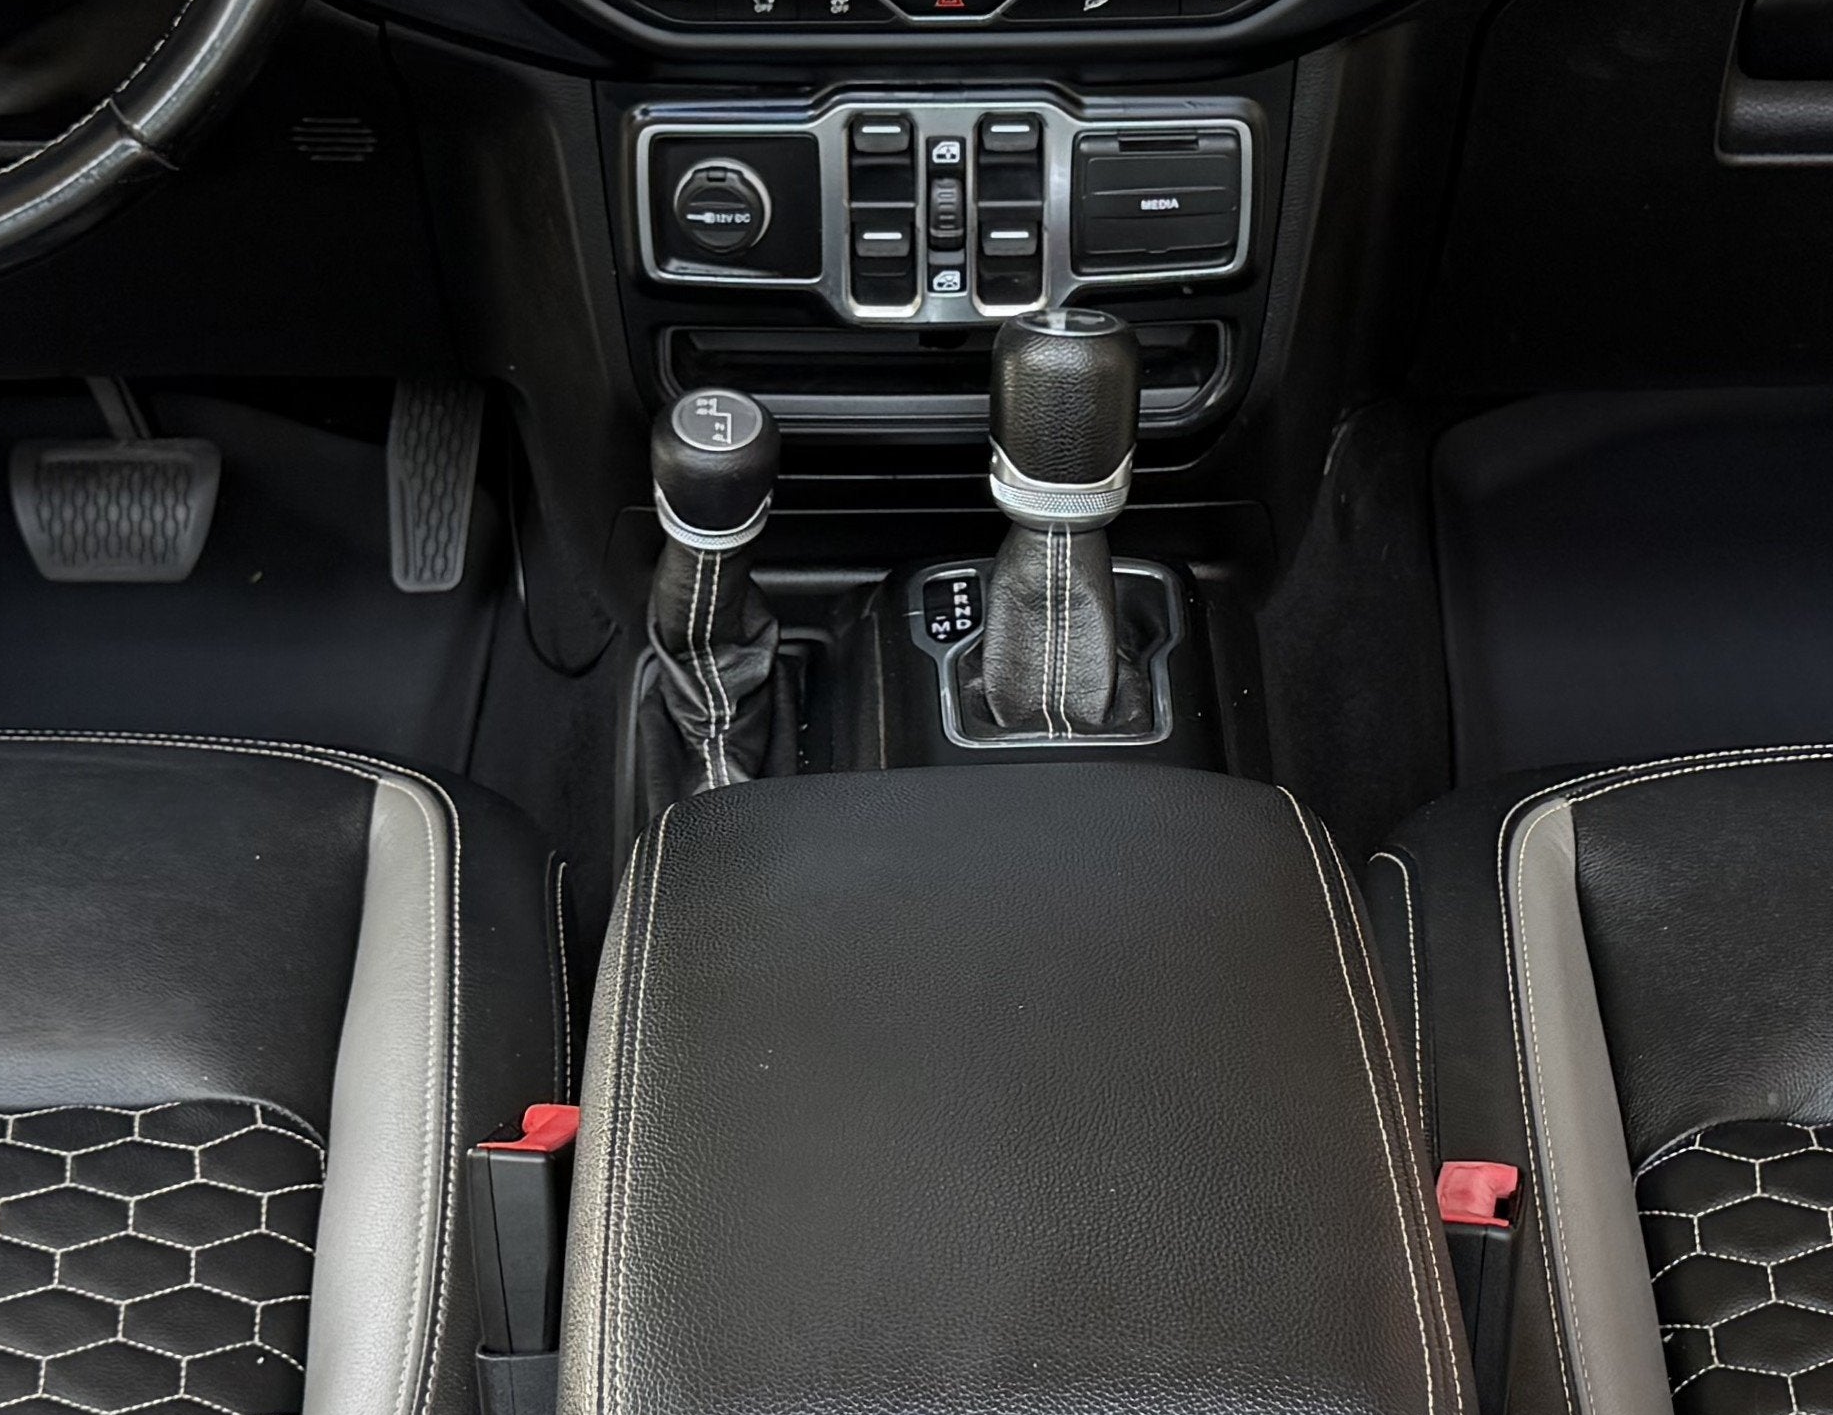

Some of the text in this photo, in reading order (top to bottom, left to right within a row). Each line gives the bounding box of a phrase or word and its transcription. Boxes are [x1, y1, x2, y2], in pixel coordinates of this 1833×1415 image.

[1140, 197, 1180, 211] MEDIA
[734, 213, 751, 224] DC
[931, 620, 951, 634] M
